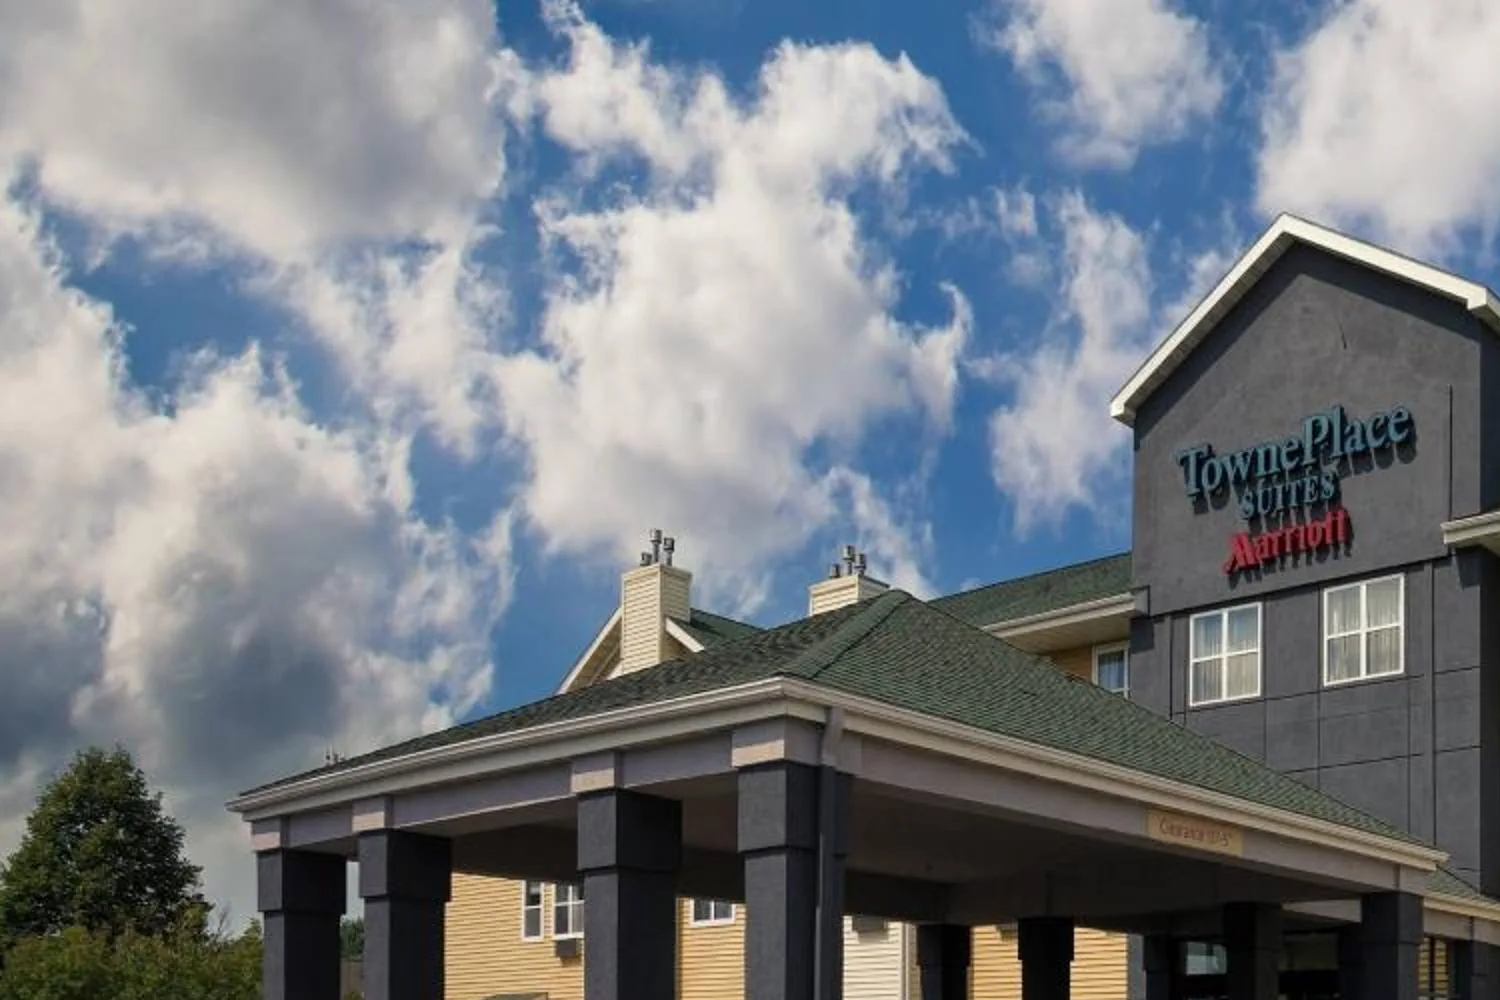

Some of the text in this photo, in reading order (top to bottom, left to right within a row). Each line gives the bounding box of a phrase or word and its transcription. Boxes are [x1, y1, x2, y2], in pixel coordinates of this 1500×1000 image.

[1178, 403, 1413, 497] TownePlace
[1239, 471, 1337, 520] SUITES
[1223, 508, 1349, 575] Marriott
